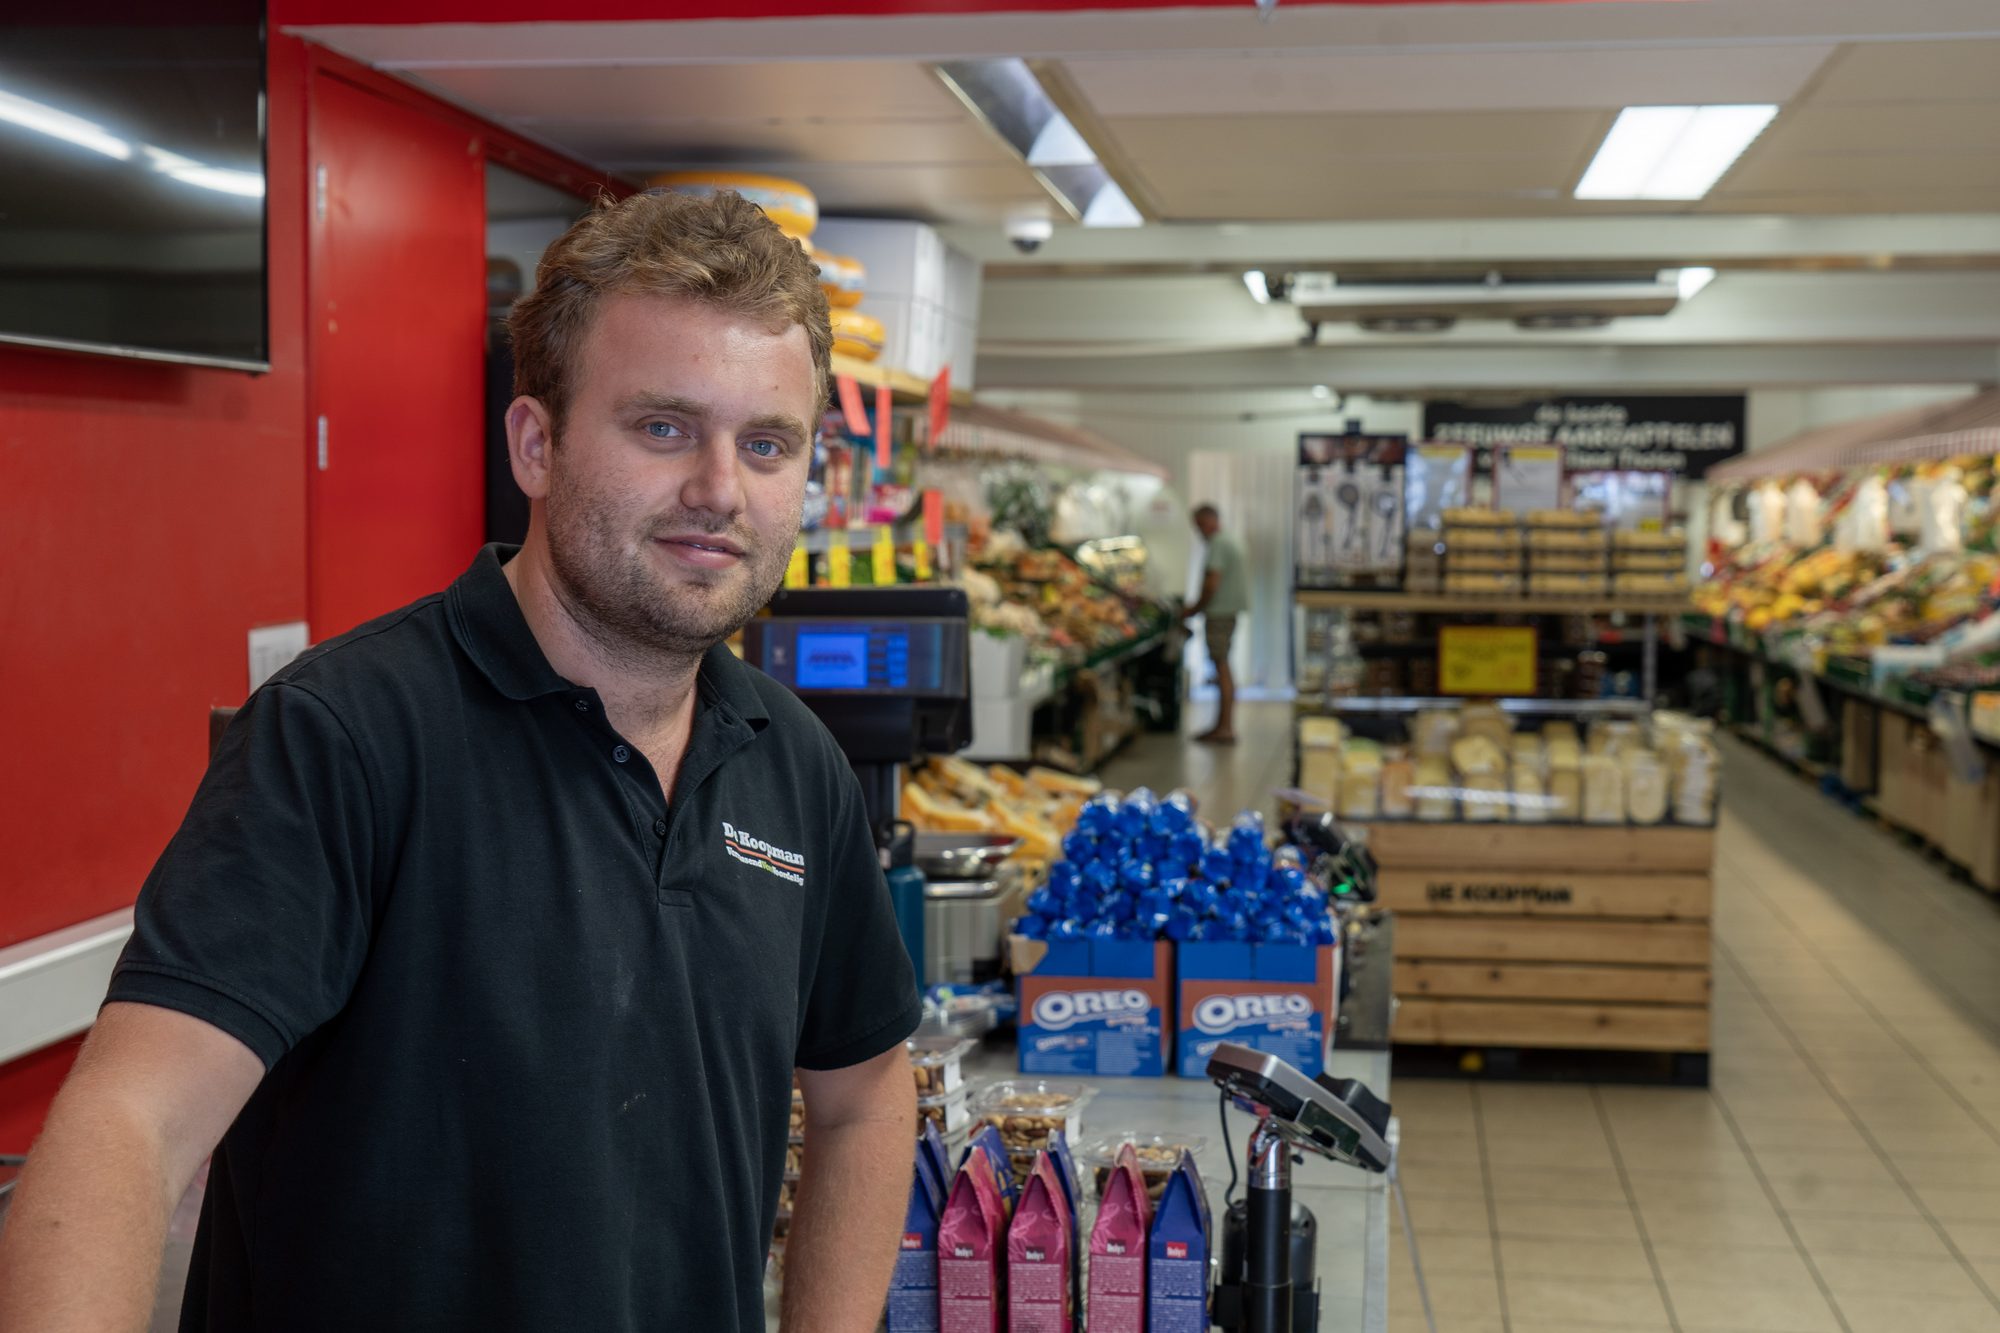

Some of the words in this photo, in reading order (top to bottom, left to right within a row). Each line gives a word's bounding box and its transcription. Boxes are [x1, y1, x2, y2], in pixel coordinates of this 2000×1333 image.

[1554, 421, 1735, 451] AARDAPPELEN
[738, 831, 804, 865] Koopman
[1034, 988, 1151, 1027] OREO
[1194, 993, 1312, 1031] OREO
